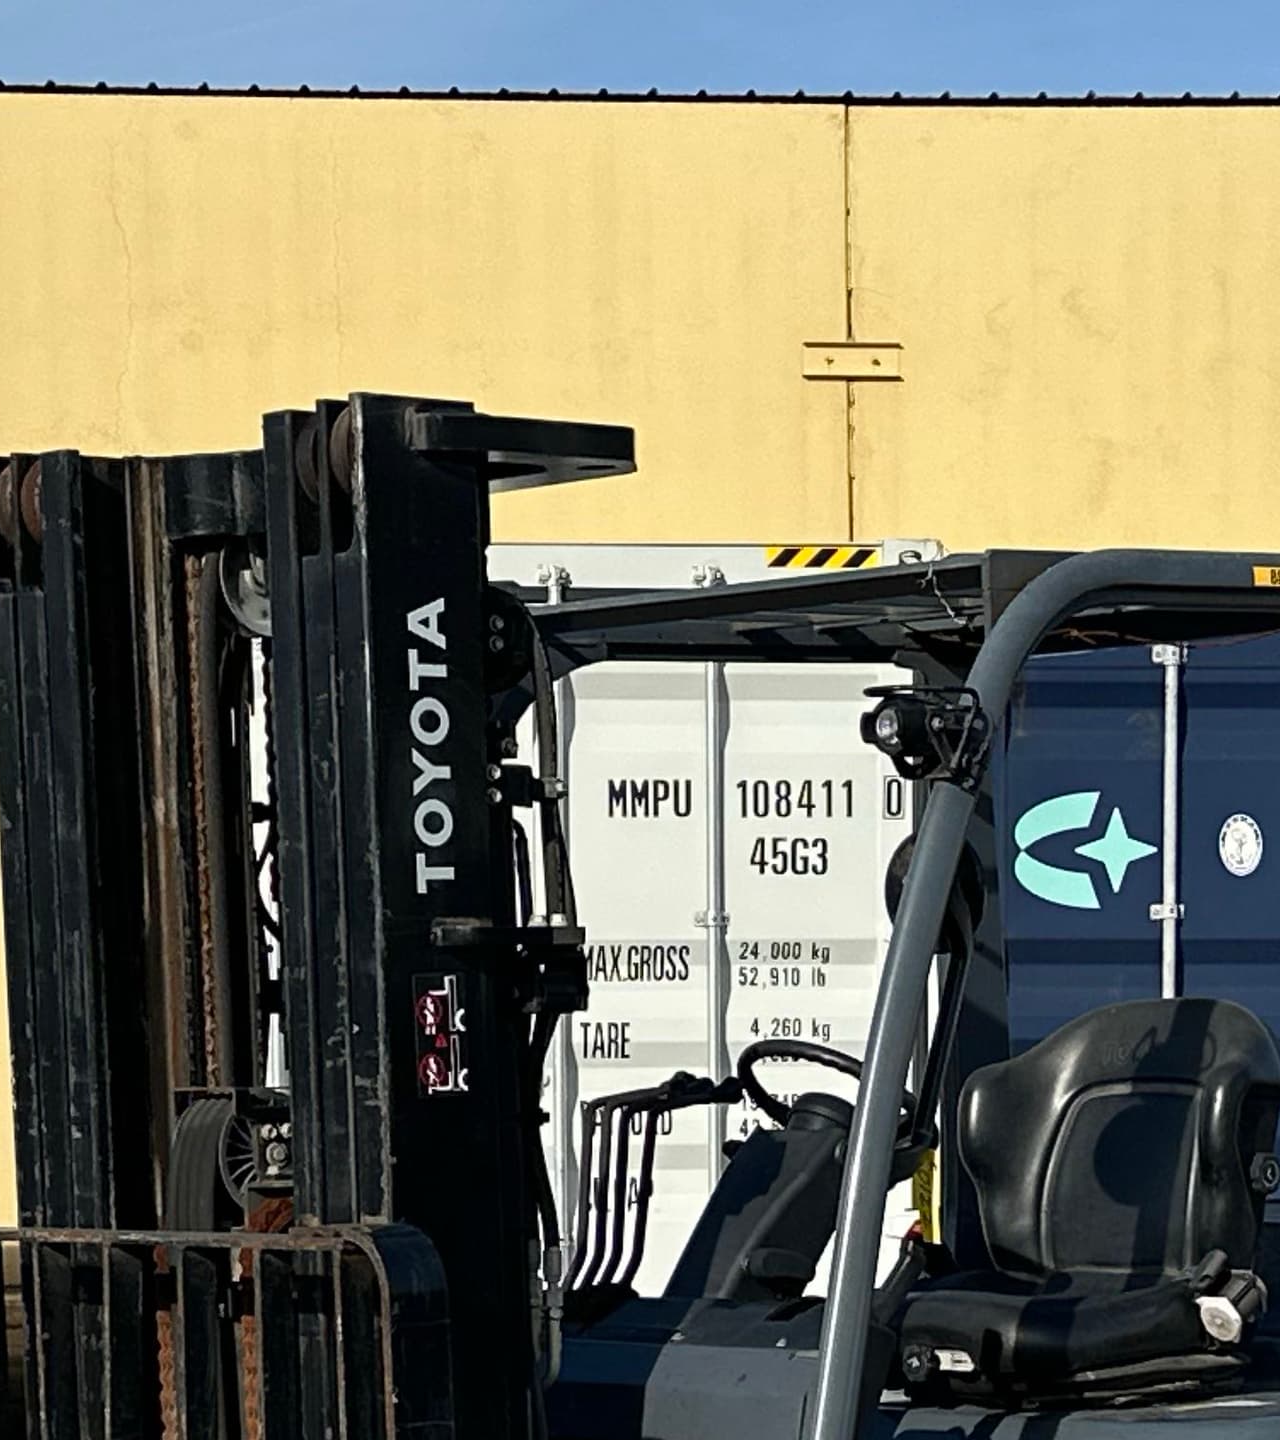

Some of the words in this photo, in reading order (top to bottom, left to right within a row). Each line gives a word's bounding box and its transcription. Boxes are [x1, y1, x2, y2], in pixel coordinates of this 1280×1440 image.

[405, 596, 456, 895] TOYOTA
[607, 778, 693, 818] MMPU
[735, 778, 856, 819] 108411
[886, 777, 901, 817] 0
[749, 837, 830, 876] 45G3
[811, 941, 830, 964] kg
[811, 966, 826, 987] lb
[580, 1022, 631, 1059] TARE
[811, 1017, 831, 1042] kg
